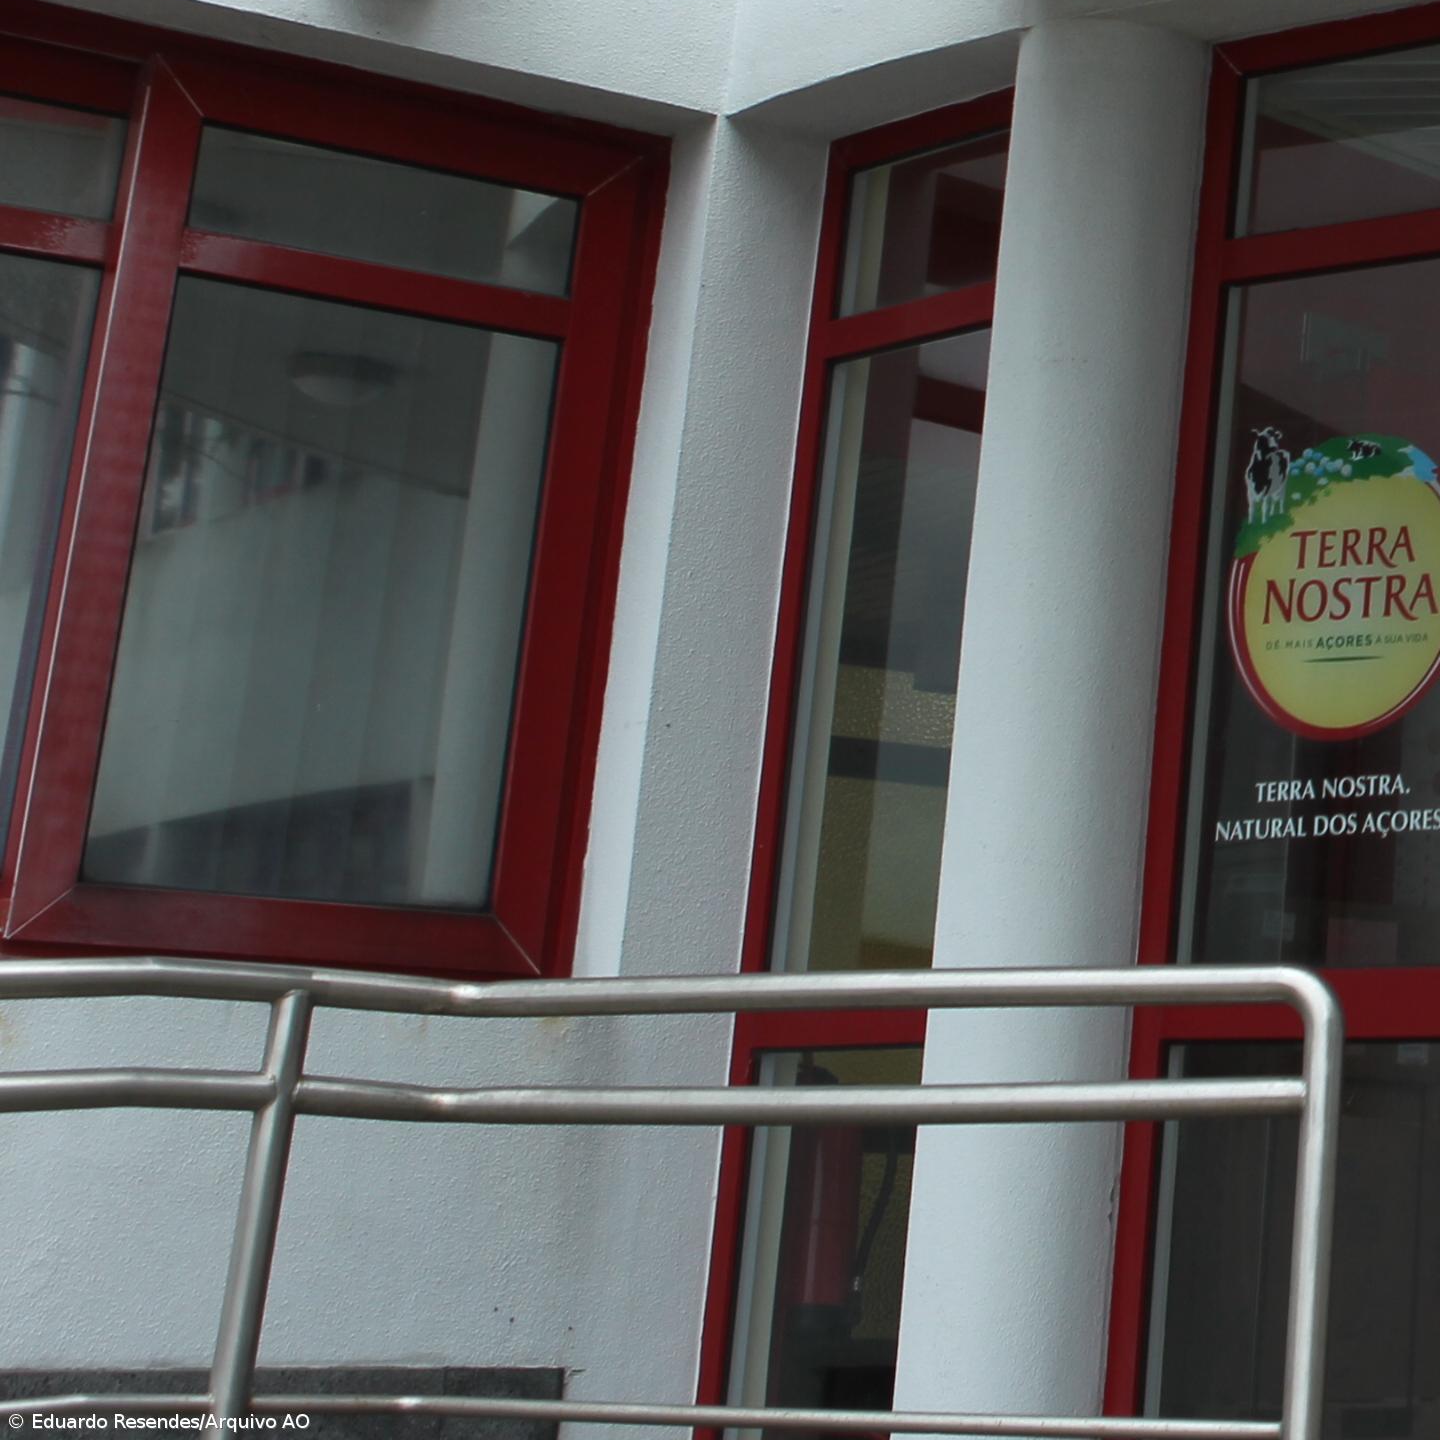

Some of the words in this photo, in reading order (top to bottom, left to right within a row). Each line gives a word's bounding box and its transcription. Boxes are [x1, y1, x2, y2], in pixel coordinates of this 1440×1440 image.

[1289, 525, 1416, 570] TERRA
[1262, 573, 1439, 625] NOSTRA
[1315, 633, 1373, 650] AÇORES
[1254, 779, 1316, 803] TERRA
[1321, 773, 1411, 800] NOSTRA.
[1214, 818, 1307, 843] NATURAL
[1312, 812, 1358, 837] DOS
